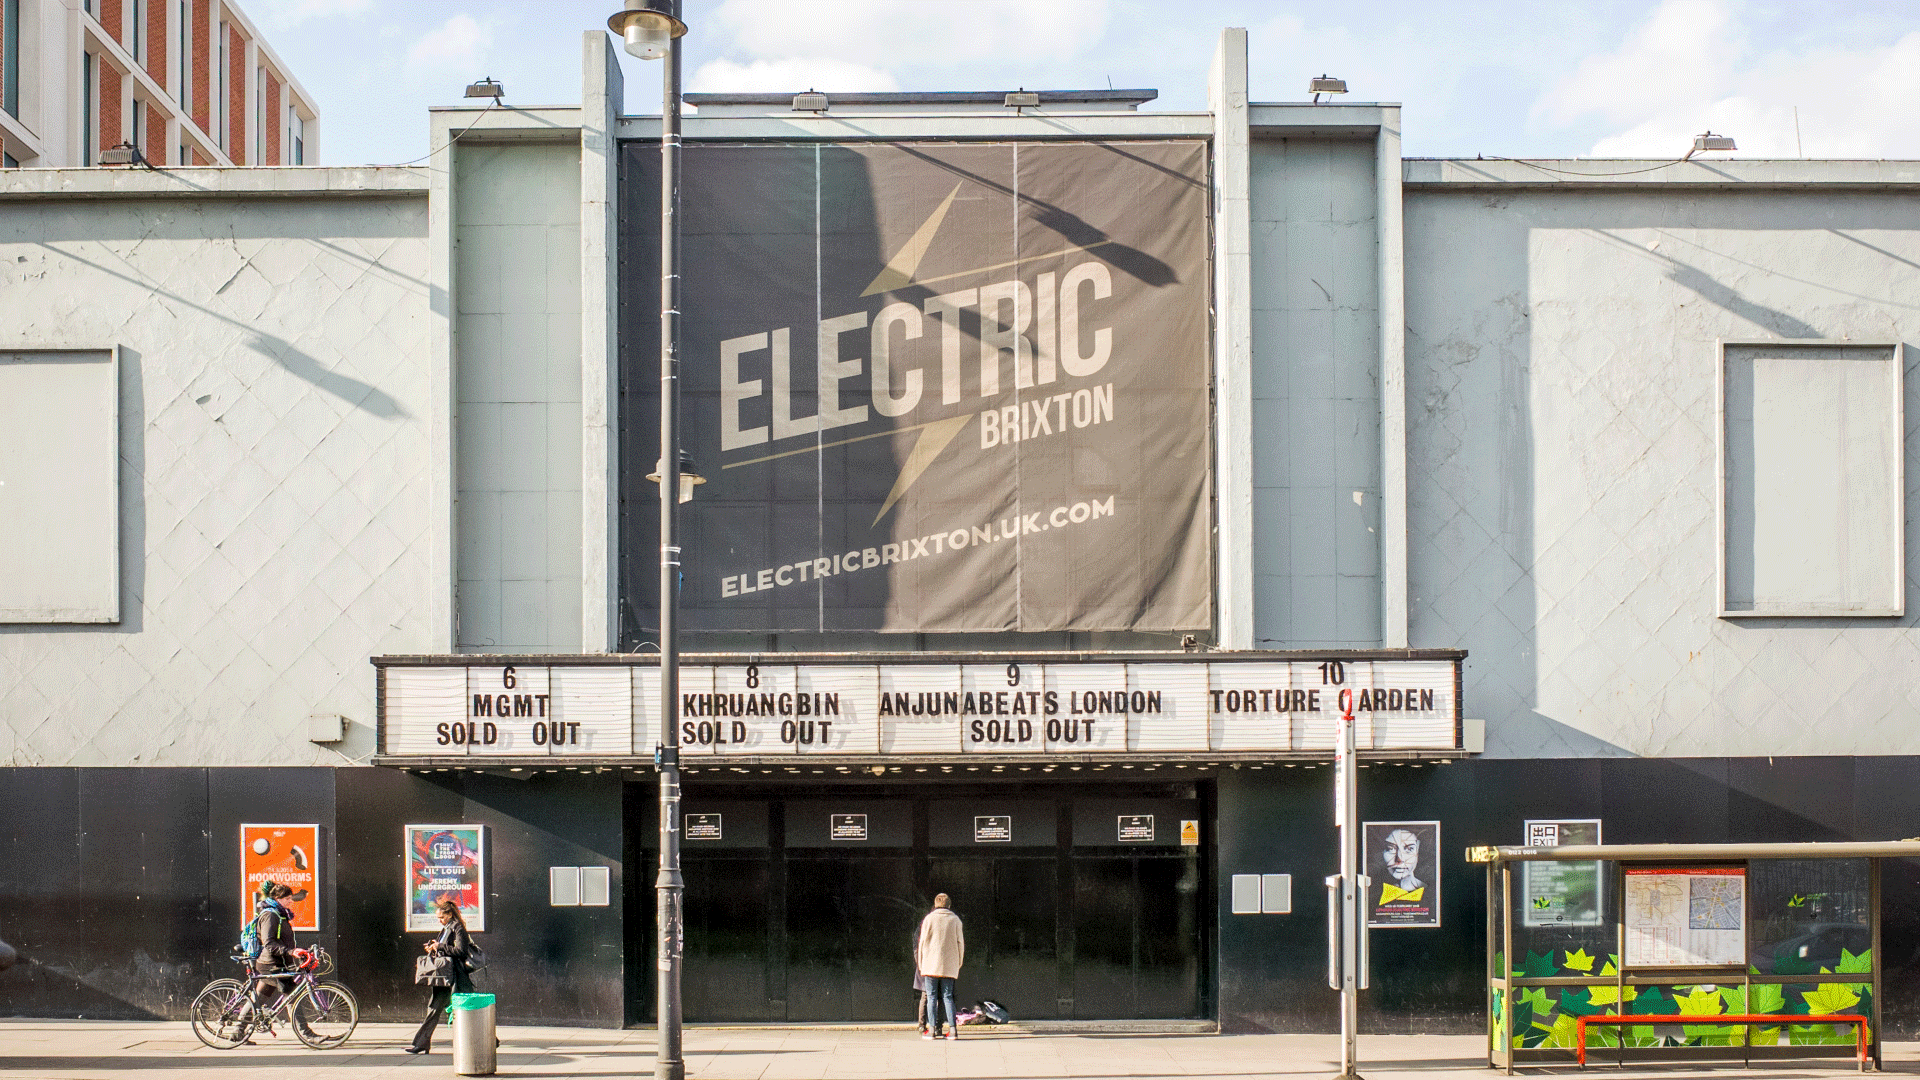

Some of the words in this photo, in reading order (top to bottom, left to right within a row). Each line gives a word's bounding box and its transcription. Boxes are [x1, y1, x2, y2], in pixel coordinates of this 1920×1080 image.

[720, 261, 1112, 452] ELECTRIC
[980, 383, 1114, 449] BRIXTON
[721, 495, 1115, 598] ELECTRICBRIXTON.UK.COM
[503, 665, 516, 689] 6
[746, 665, 759, 688] 8
[1007, 663, 1020, 686] 9
[1319, 661, 1345, 684] 10
[474, 695, 549, 717] MGMT
[683, 693, 838, 716] KHRUANGBIN
[879, 692, 1058, 715] ANJUNABEATS
[1071, 691, 1161, 714] LONDON
[1210, 689, 1320, 713] TORTURE
[437, 722, 497, 745] SOLD
[533, 722, 580, 745] OUT
[683, 722, 746, 744] SOLD
[781, 721, 831, 744] OUT
[971, 720, 1032, 743] SOLD
[1047, 719, 1095, 742] OUT
[1533, 838, 1555, 846] EXIT
[249, 873, 312, 882] HOOKWORMS
